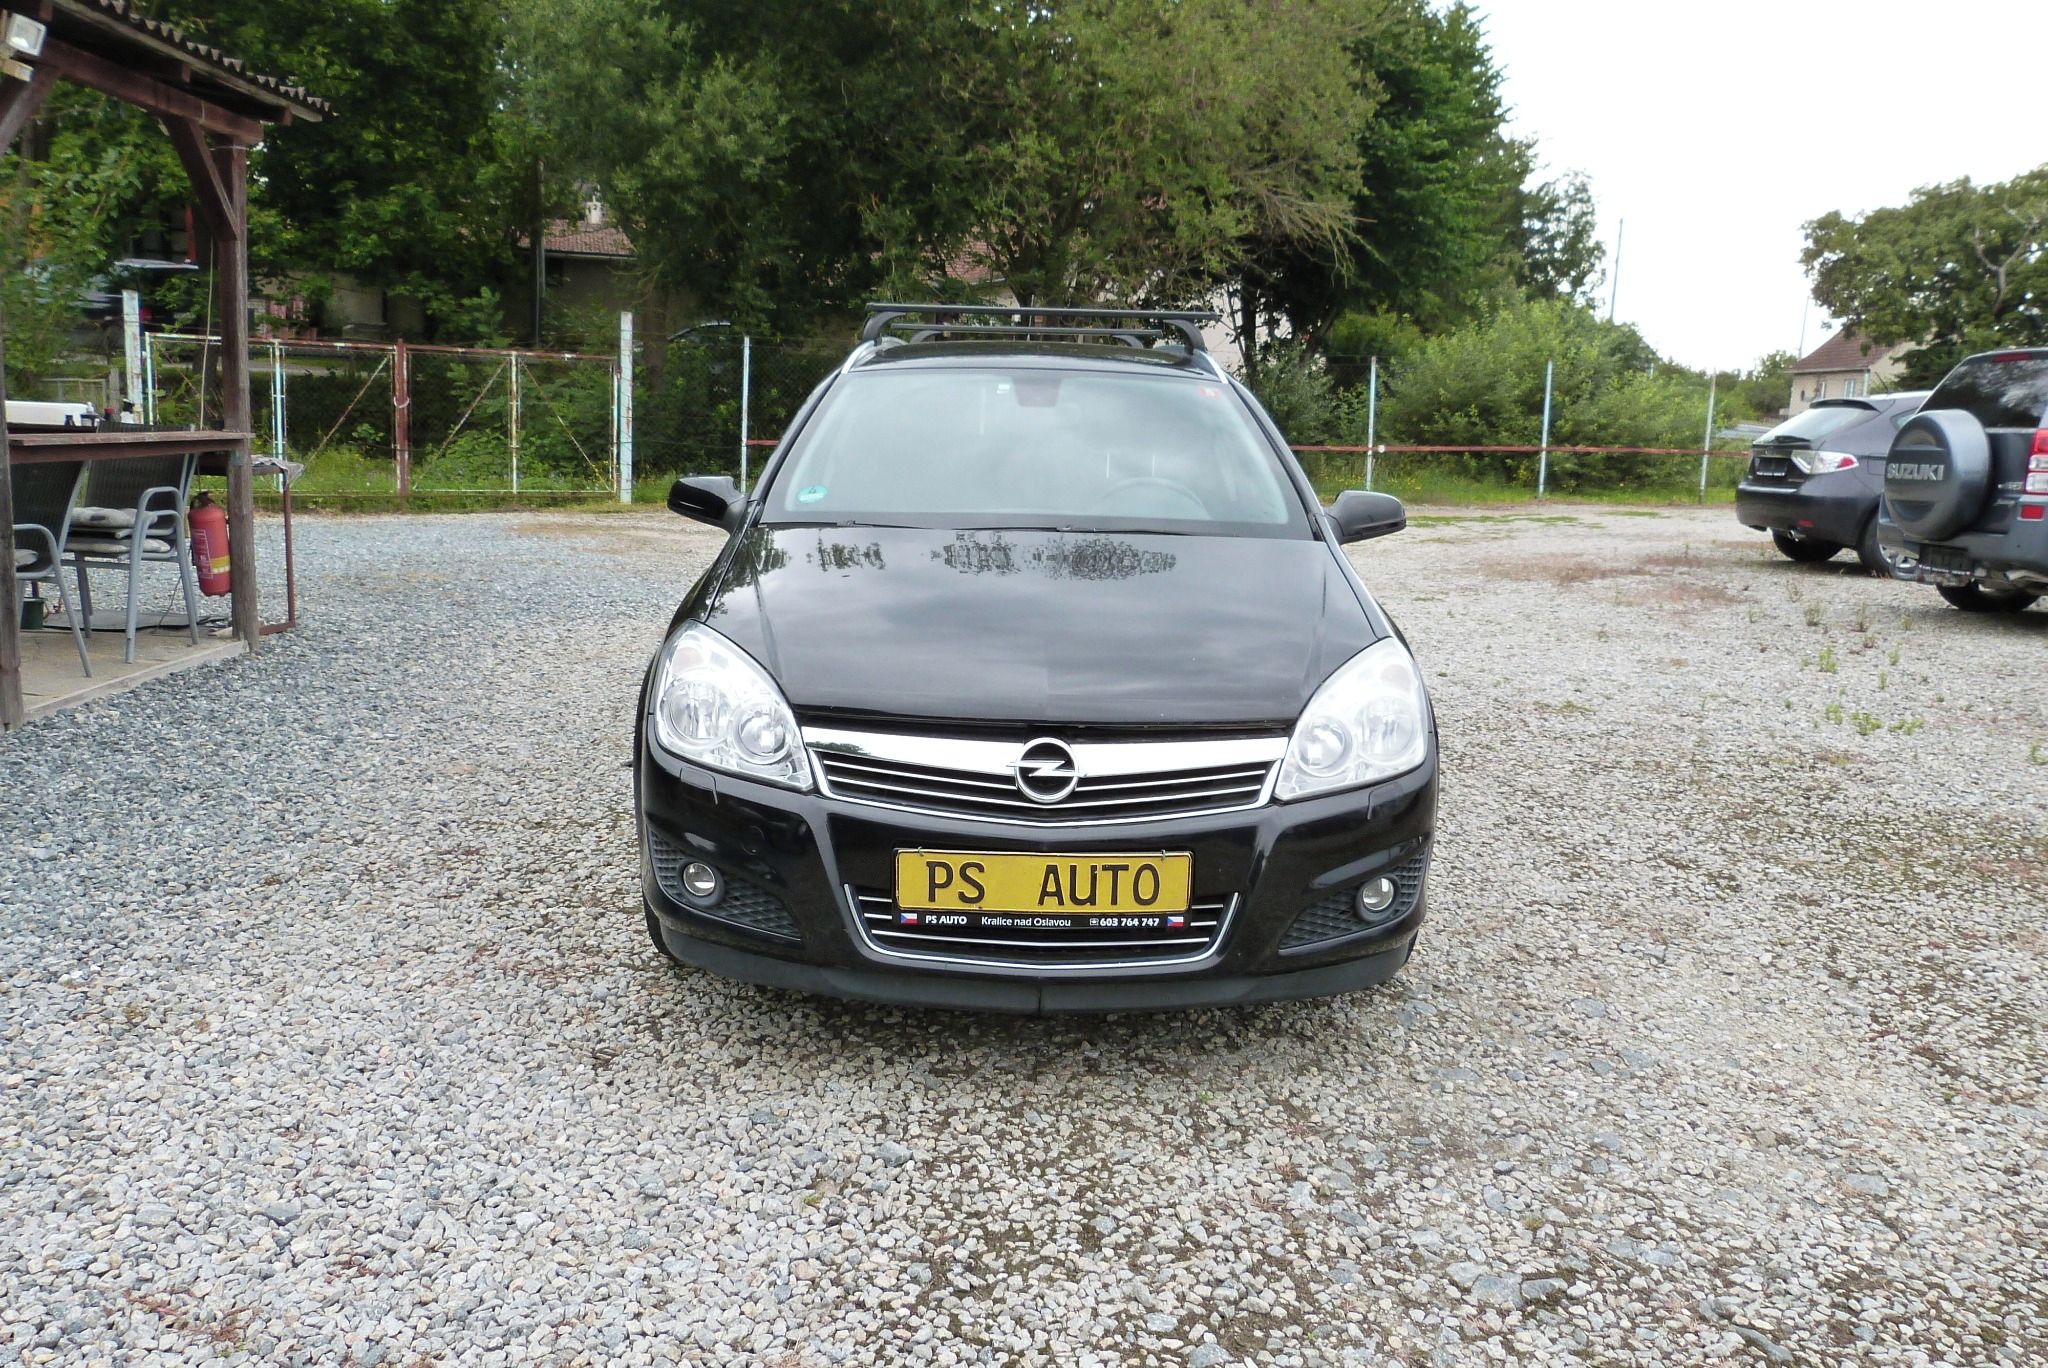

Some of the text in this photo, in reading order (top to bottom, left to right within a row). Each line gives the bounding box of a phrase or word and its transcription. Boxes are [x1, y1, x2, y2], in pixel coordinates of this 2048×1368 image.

[1887, 463, 1945, 481] SUZUKI
[926, 860, 1161, 906] PS AUTO
[925, 915, 1160, 927] PS AUTO Kralice nad Oslavou 603 764 747
